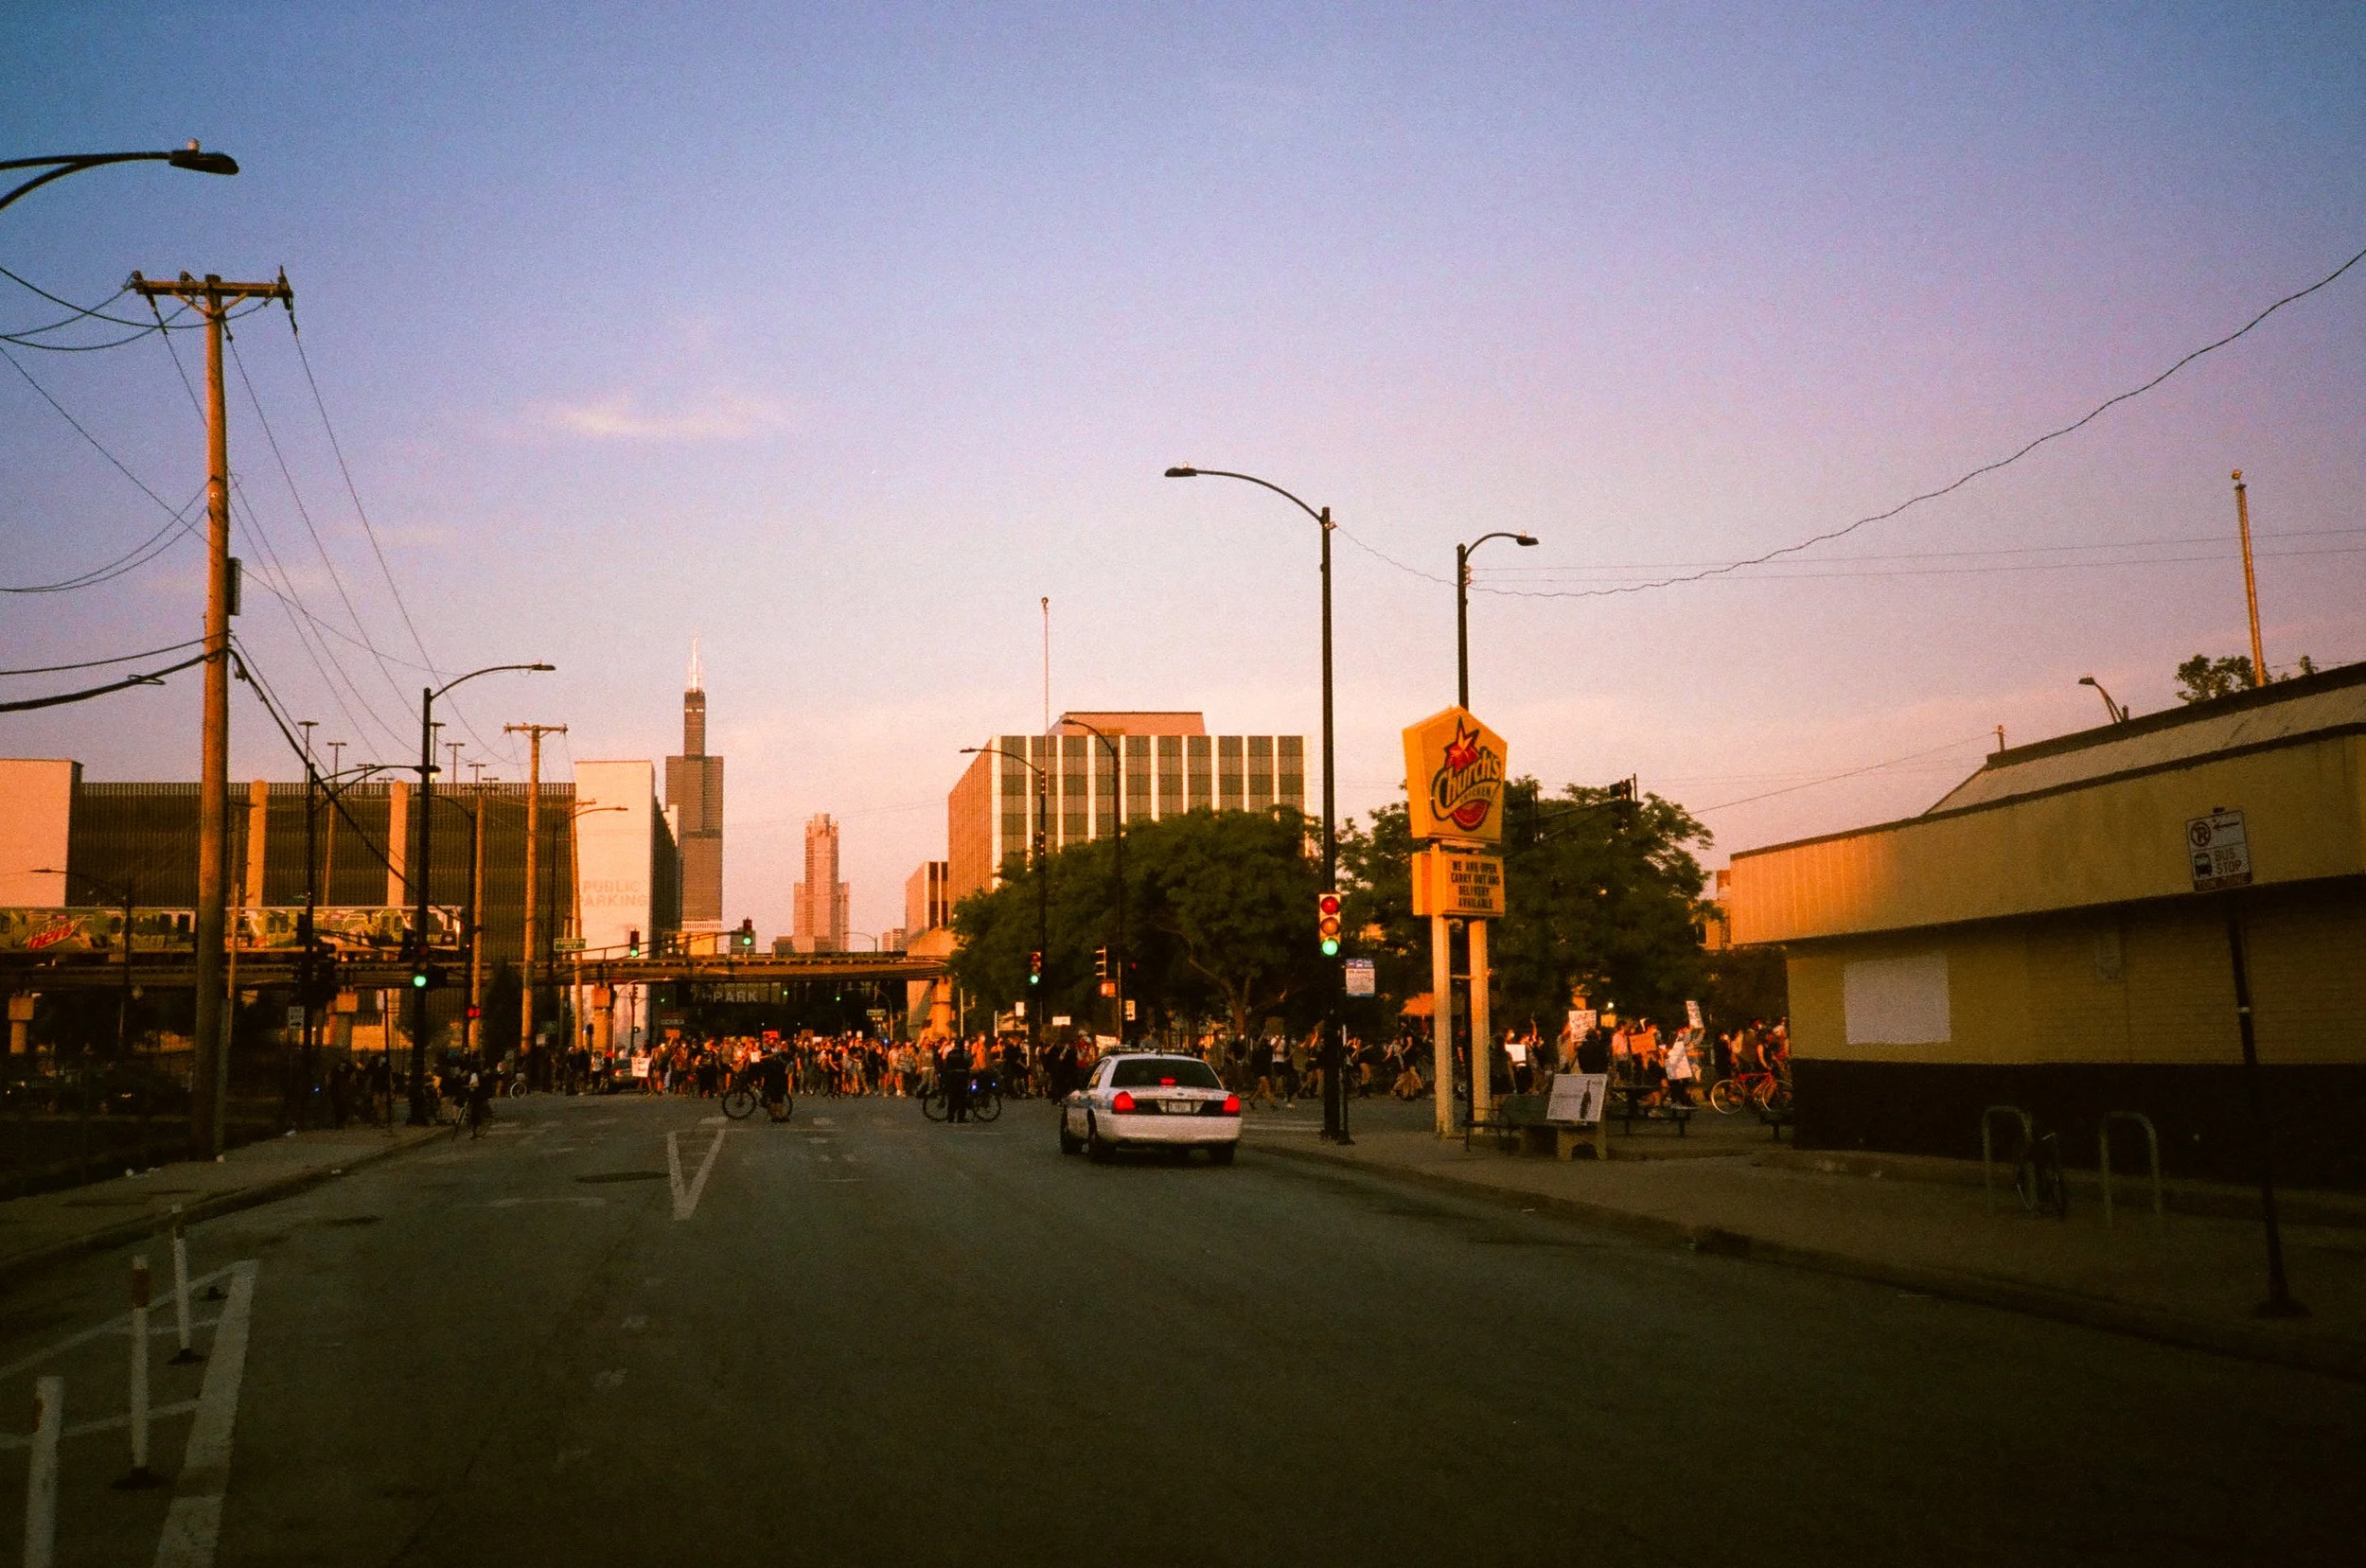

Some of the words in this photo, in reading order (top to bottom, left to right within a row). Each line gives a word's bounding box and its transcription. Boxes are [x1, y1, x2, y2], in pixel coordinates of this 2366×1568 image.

[1432, 747, 1500, 820] Church's
[2215, 848, 2235, 862] BUS
[1453, 860, 1461, 871] WE
[1466, 862, 1477, 872] ARE
[1480, 863, 1497, 873] OPEN
[2216, 860, 2242, 874] STOP
[584, 880, 641, 892] PUBLIC
[1451, 873, 1471, 883] CARRY
[1474, 874, 1486, 885] OUT
[1488, 875, 1500, 886] AND
[1458, 886, 1491, 896] DELIVERY
[1458, 898, 1492, 908] AVAILABLE
[714, 991, 758, 1003] PARK
